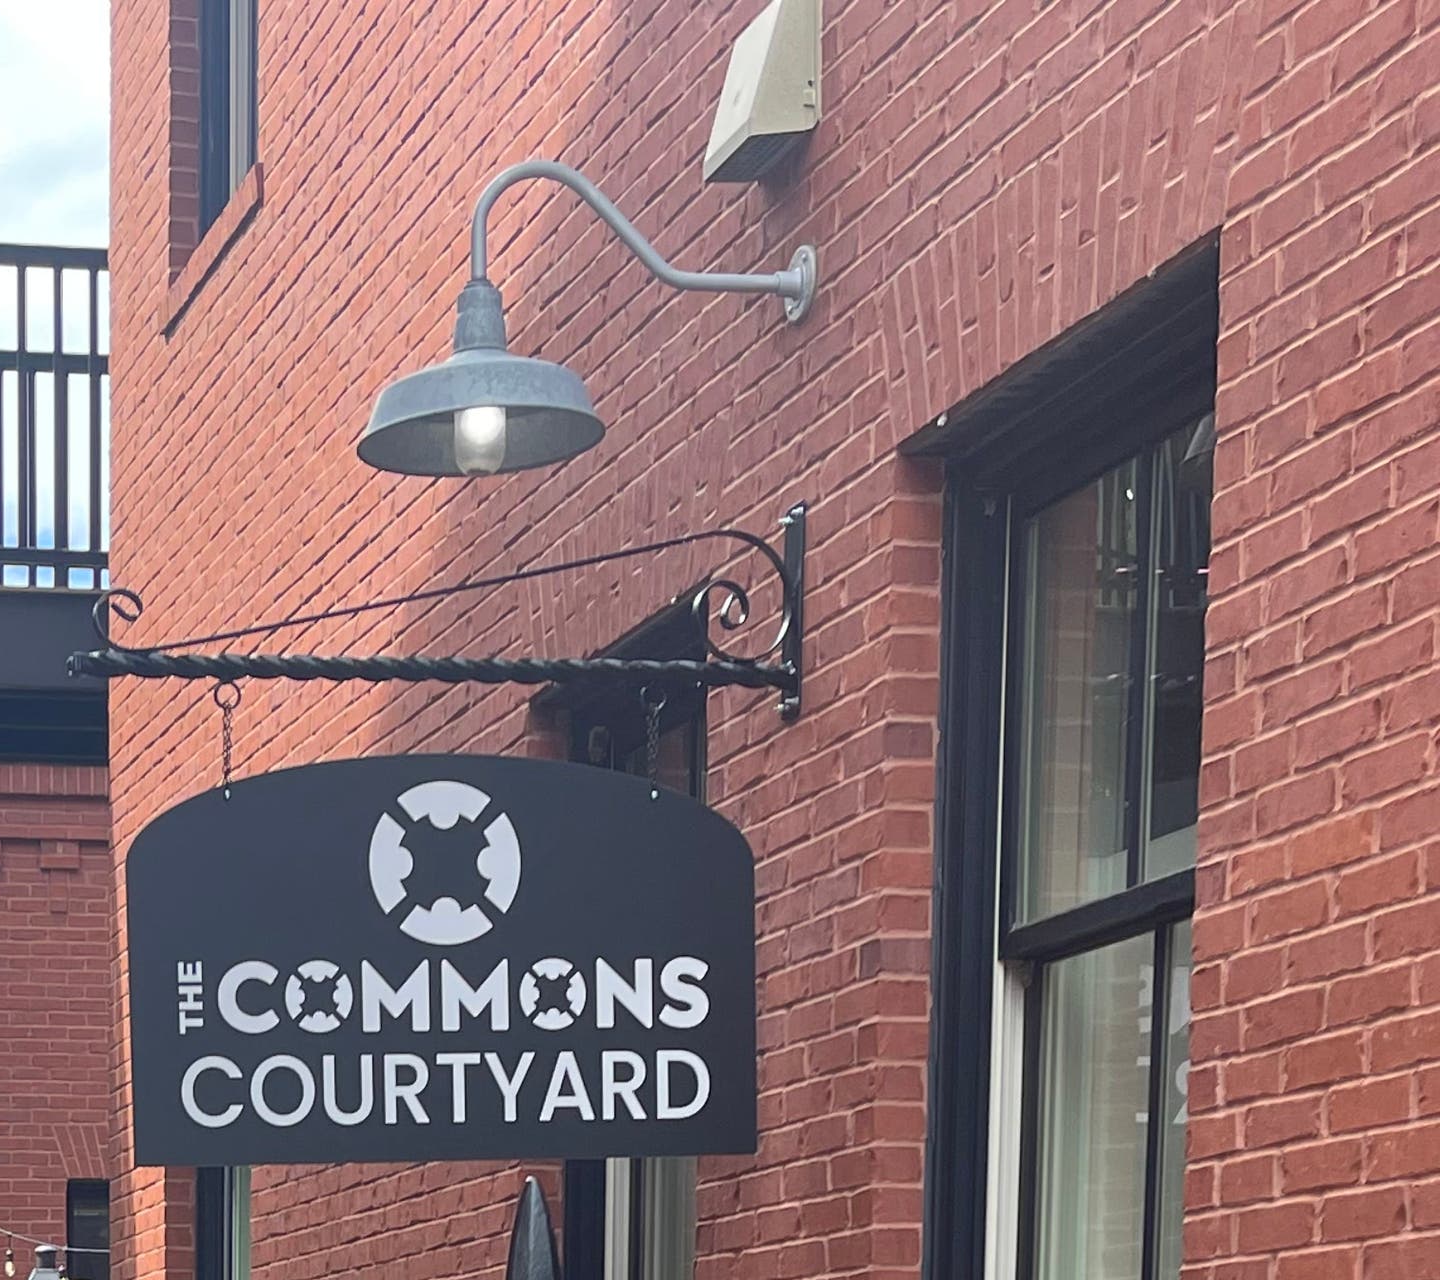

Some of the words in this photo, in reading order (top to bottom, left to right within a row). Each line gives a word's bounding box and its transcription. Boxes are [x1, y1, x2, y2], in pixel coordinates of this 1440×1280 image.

[177, 960, 204, 1035] THE
[217, 956, 710, 1034] COMMONS
[180, 1049, 711, 1128] COURTYARD
